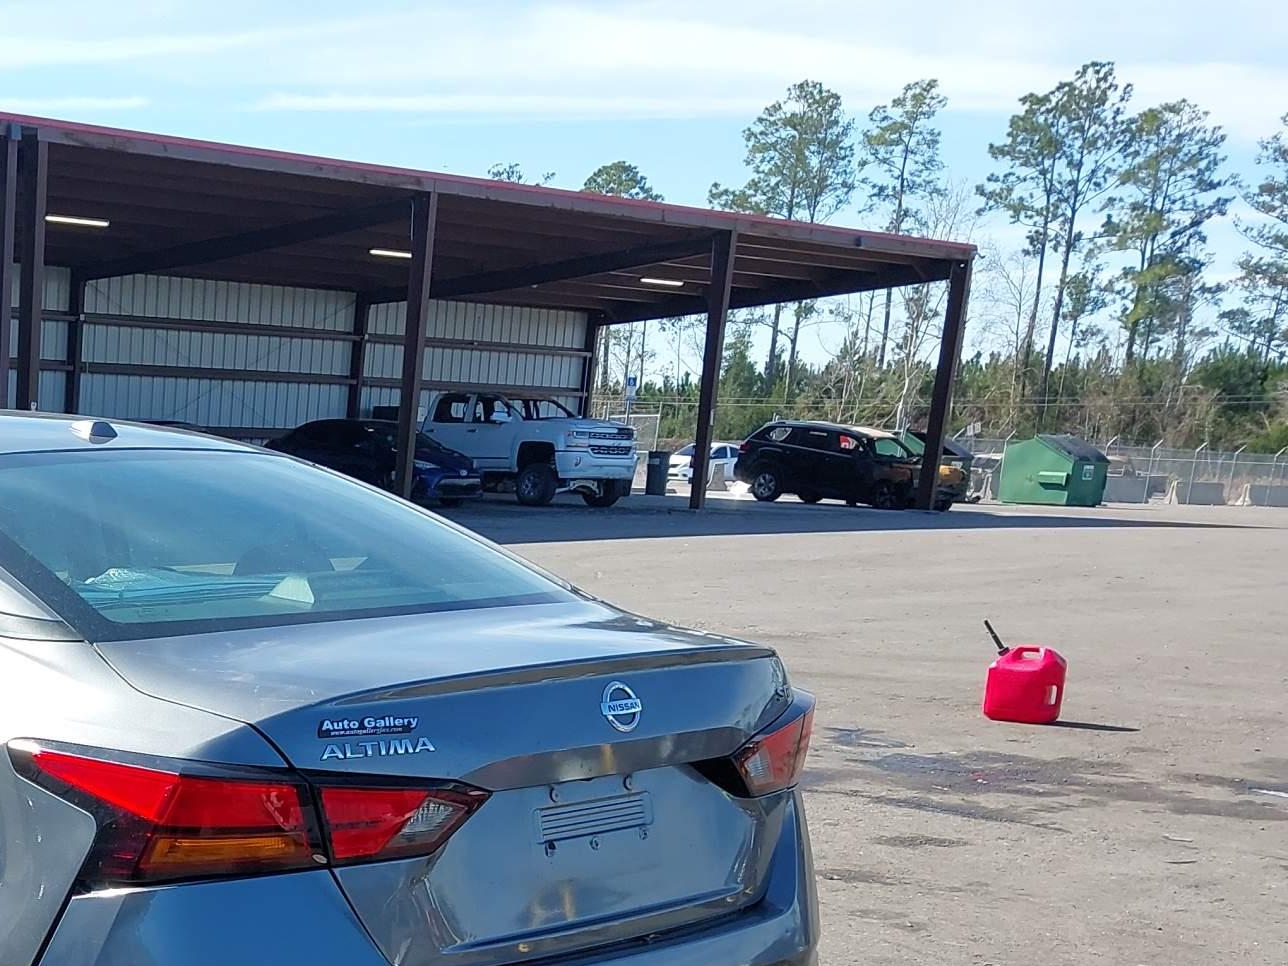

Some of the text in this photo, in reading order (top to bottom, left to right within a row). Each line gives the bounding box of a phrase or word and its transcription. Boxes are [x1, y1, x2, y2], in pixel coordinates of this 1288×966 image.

[607, 701, 640, 713] NISSAN
[321, 716, 418, 731] Auto Gallery
[320, 737, 436, 760] ALTIMA
